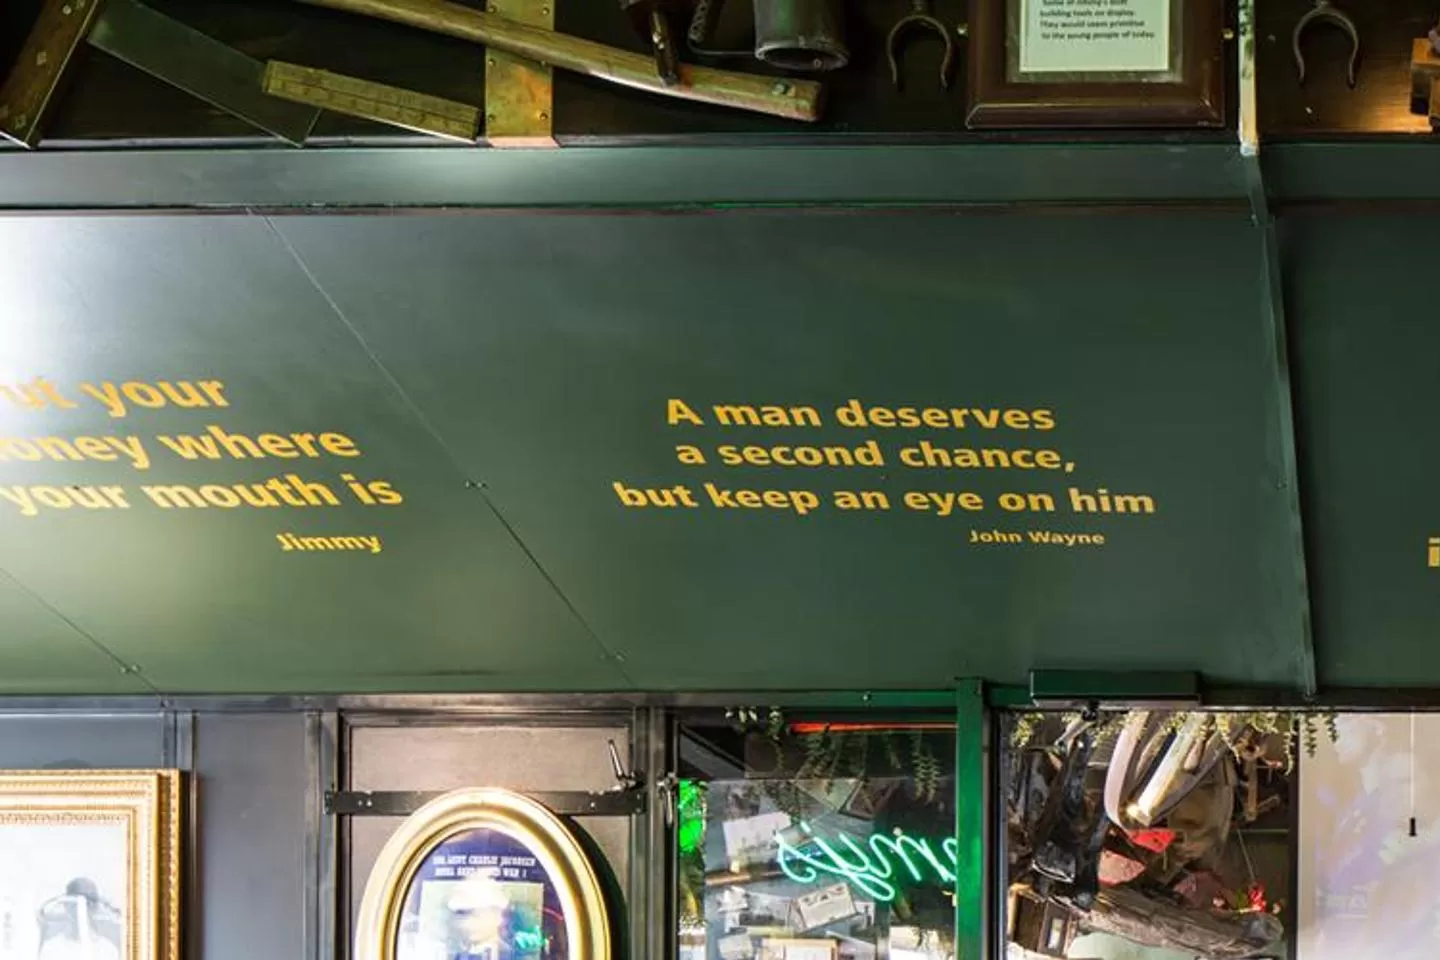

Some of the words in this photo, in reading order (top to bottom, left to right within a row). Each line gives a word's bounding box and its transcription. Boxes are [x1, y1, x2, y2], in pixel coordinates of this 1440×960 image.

[80, 379, 229, 418] your
[665, 397, 703, 427] A
[713, 403, 822, 428] man
[834, 399, 1056, 431] deserves
[0, 434, 150, 470] oney
[156, 424, 361, 461] where
[677, 443, 706, 466] a
[716, 440, 885, 467] second
[898, 440, 1076, 474] chance,
[0, 485, 131, 516] your
[140, 473, 341, 509] mouth
[339, 473, 403, 506] is
[611, 482, 699, 510] but
[704, 482, 820, 516] keep
[833, 490, 891, 510] an
[904, 490, 985, 517] eye
[996, 492, 1056, 513] on
[1068, 487, 1156, 514] him
[275, 531, 384, 555] Jimmy
[970, 530, 1023, 545] John
[1028, 531, 1106, 549] Wayne
